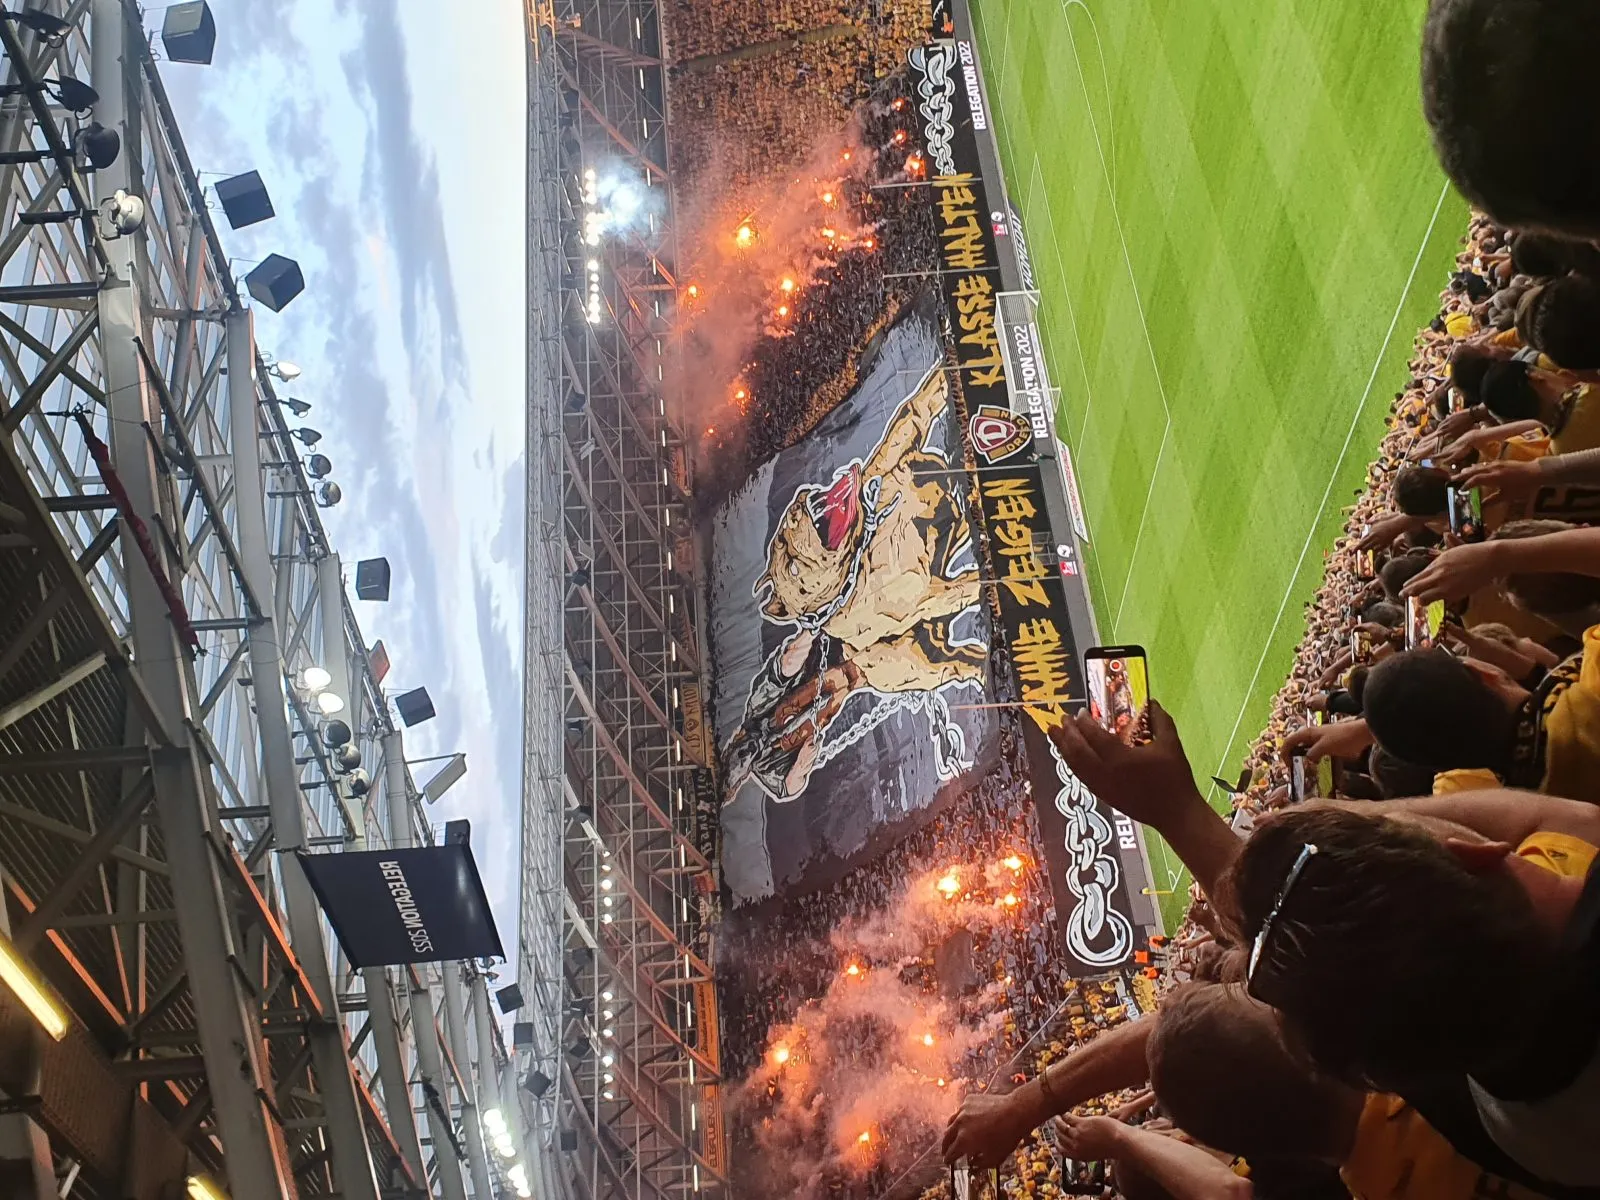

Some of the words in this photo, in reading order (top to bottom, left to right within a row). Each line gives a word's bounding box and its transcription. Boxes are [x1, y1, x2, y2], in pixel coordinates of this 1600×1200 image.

[958, 41, 973, 64] 2022
[962, 65, 986, 130] RELEGATION
[931, 173, 986, 269] HALTEN
[1009, 208, 1034, 288] HOMEDAY
[951, 275, 1005, 388] KLASSE
[1013, 325, 1031, 354] 2022
[1020, 357, 1049, 438] RELEGATION
[981, 479, 1051, 608] ZEIGEN
[1012, 618, 1070, 734] ZÄHNE
